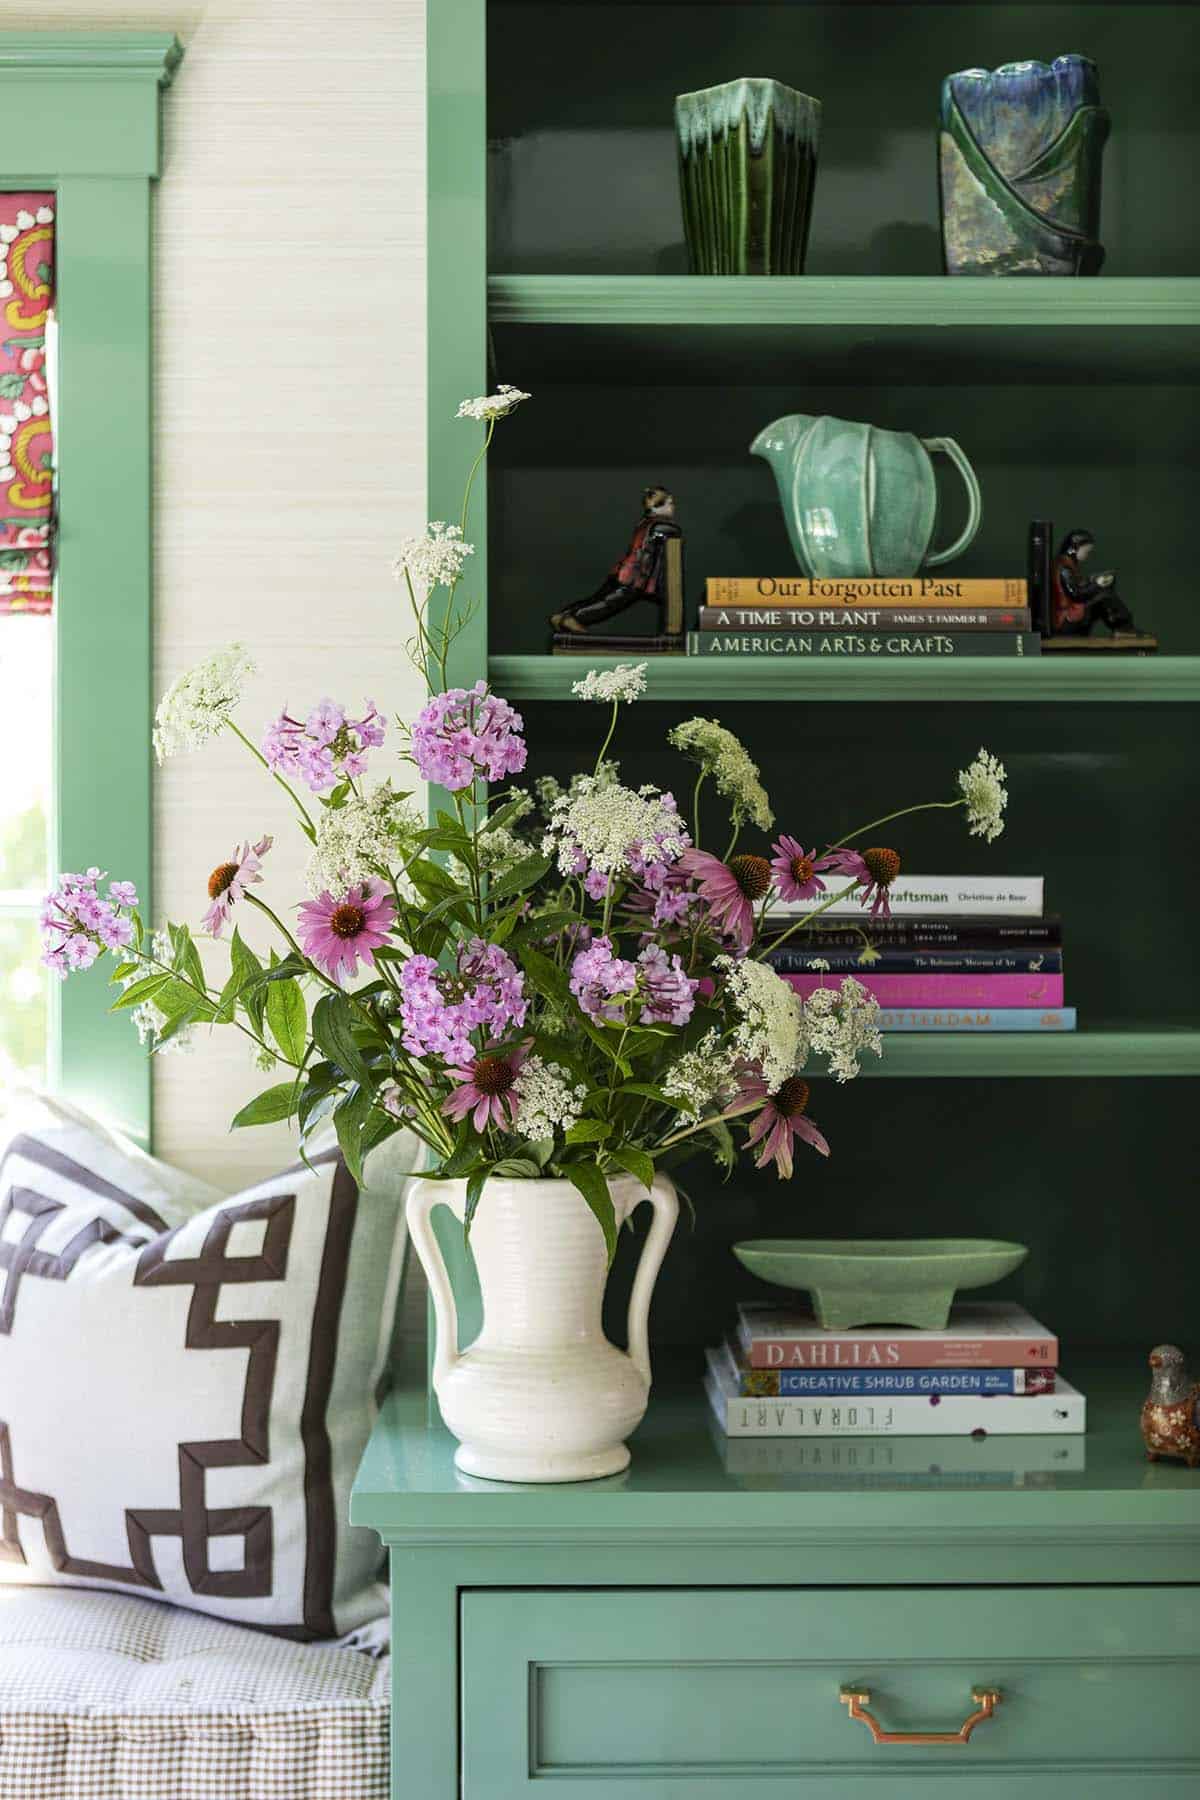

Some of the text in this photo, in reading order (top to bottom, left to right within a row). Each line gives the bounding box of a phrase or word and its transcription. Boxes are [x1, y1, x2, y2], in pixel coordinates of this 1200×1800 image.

[757, 577, 801, 596] Our
[808, 577, 913, 604] Forgotten
[919, 577, 963, 597] Past
[717, 611, 881, 625] A TIME TO PLANT
[893, 614, 925, 624] JAMES
[936, 614, 977, 624] FARMER
[709, 637, 812, 652] AMERICAN
[820, 635, 867, 652] ARTS
[869, 637, 883, 652] &
[887, 635, 954, 653] CRAFTS
[889, 890, 948, 902] raftsman
[957, 893, 994, 901] Christine
[996, 893, 1006, 901] de
[877, 1013, 991, 1026] OTTERDAM
[767, 1343, 900, 1365] DAHLIAS
[790, 1375, 861, 1389] CREATIVE
[863, 1375, 915, 1389] SHRUB
[919, 1375, 981, 1389] GARDEN
